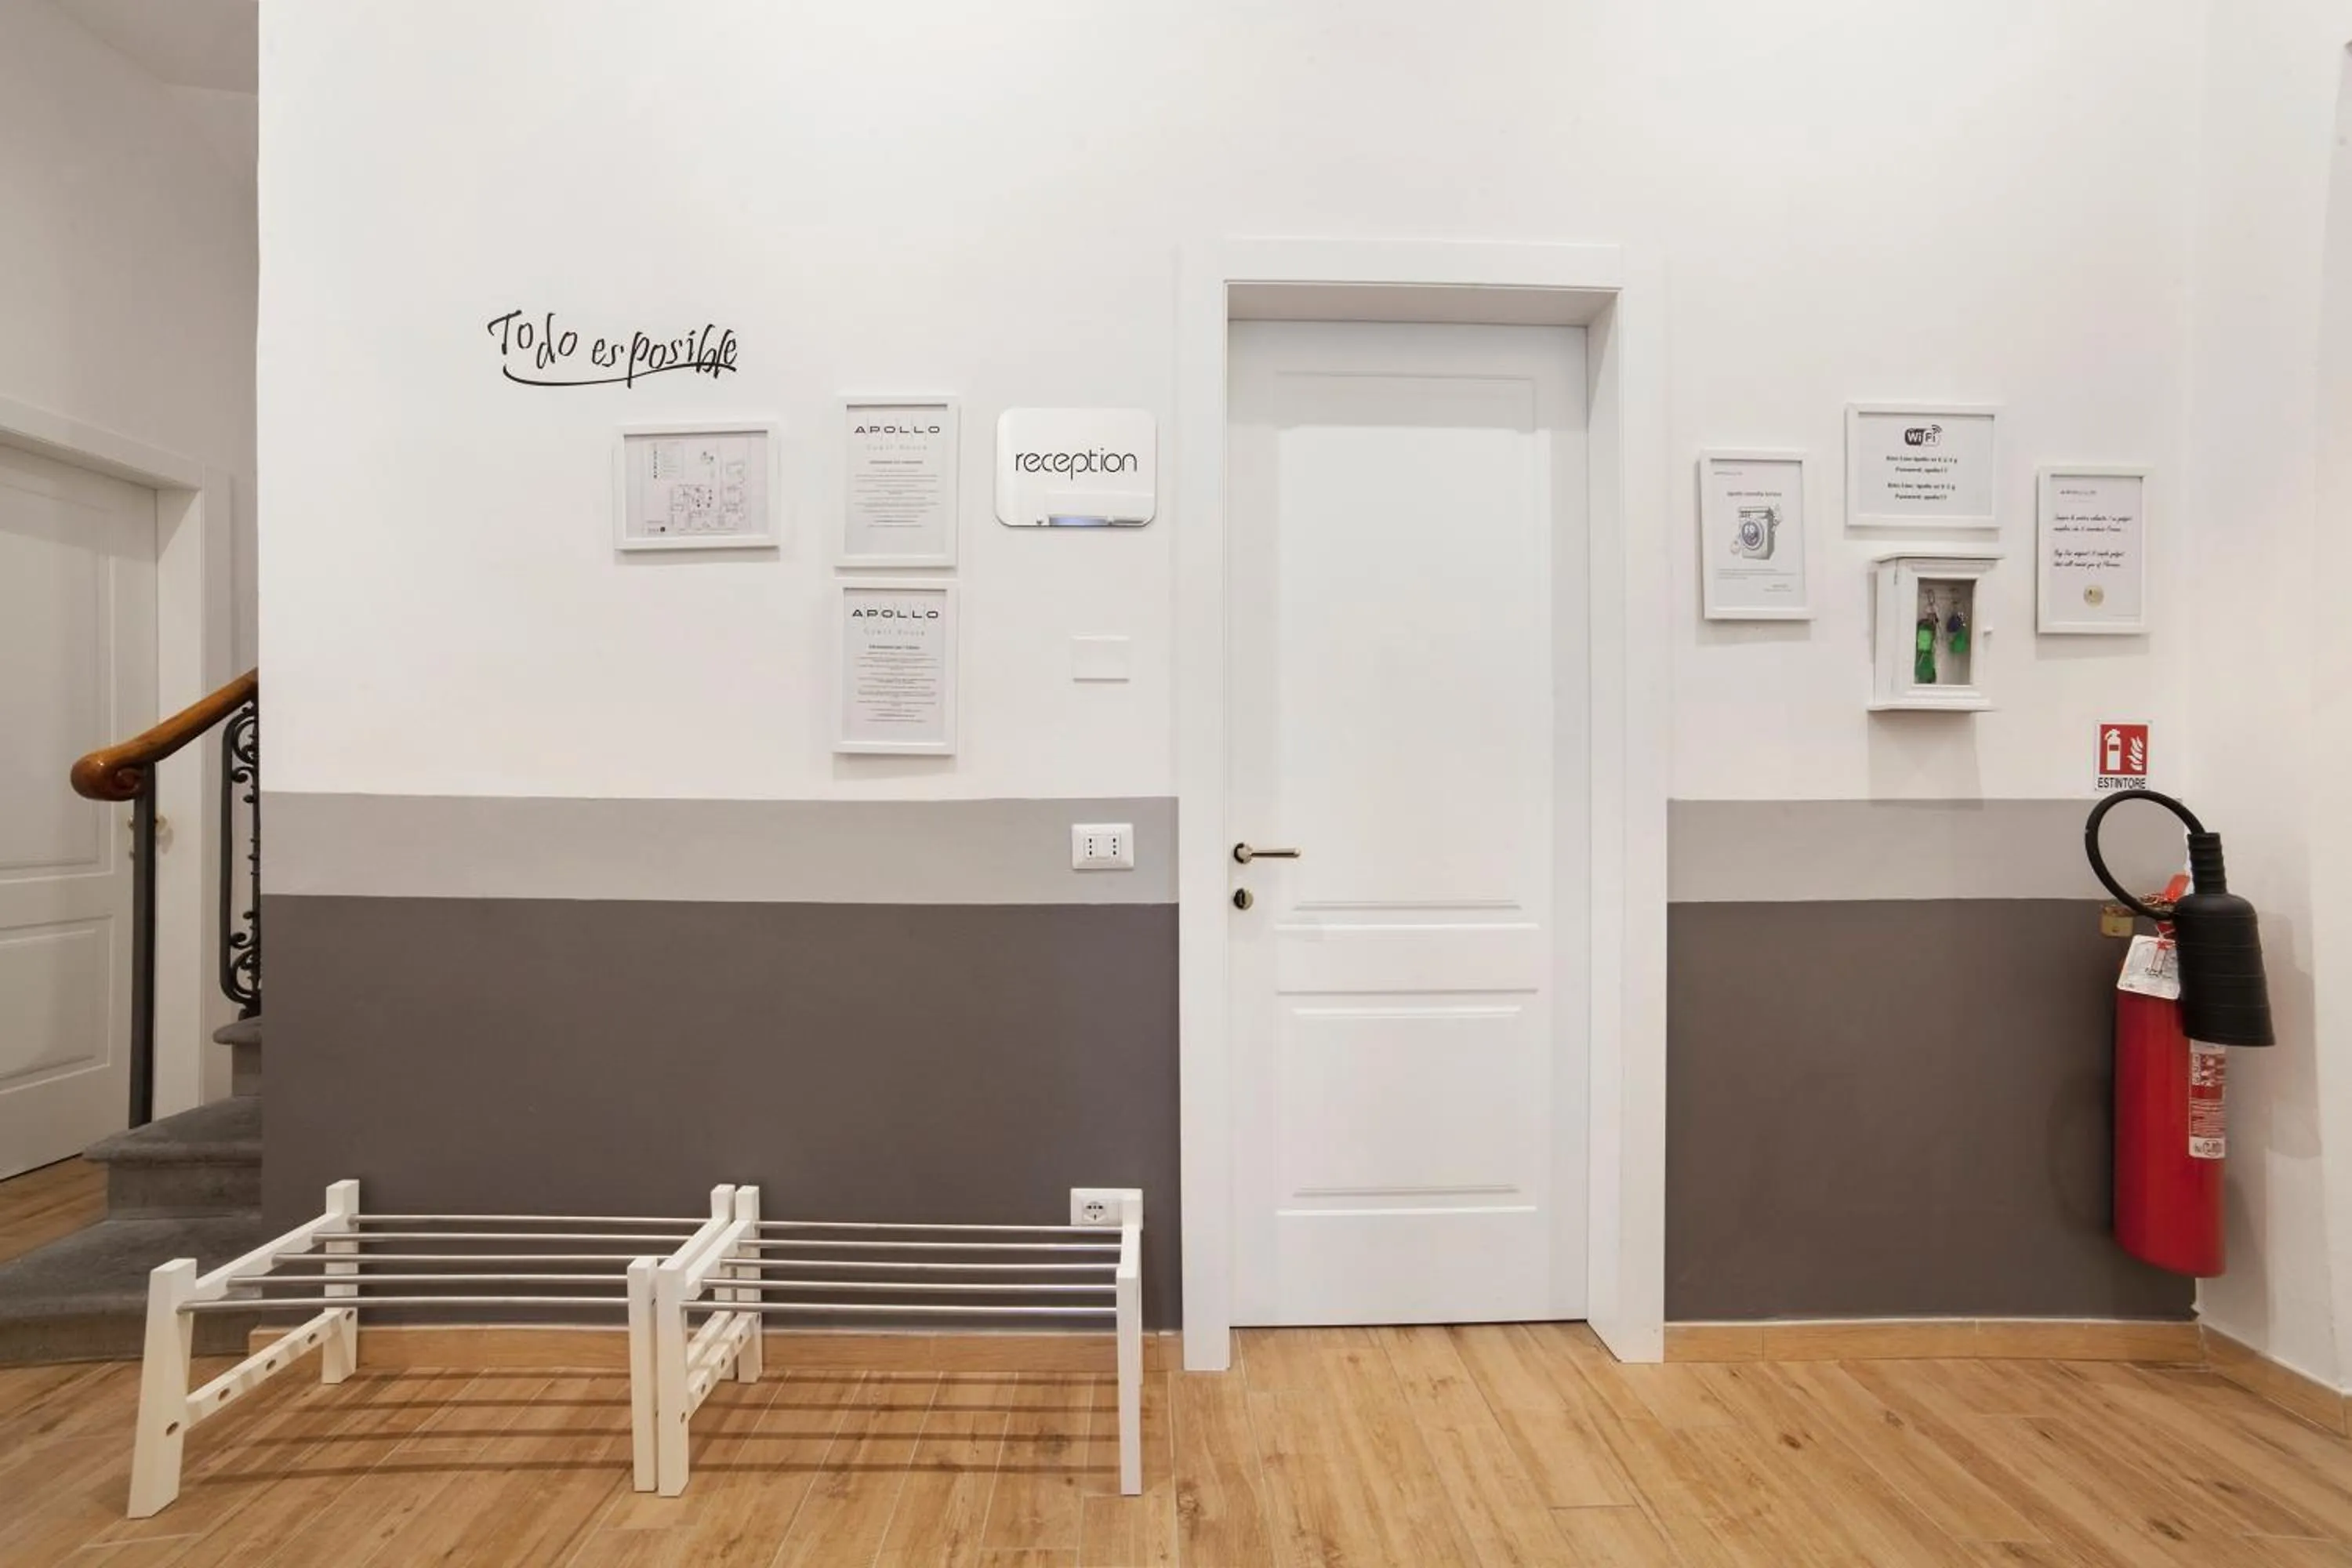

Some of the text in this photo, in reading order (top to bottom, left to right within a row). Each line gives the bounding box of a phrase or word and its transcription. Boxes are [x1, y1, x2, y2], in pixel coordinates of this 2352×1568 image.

[487, 310, 738, 390] Todo es posible
[854, 426, 941, 434] APOLLO
[1015, 447, 1138, 481] reception
[851, 608, 939, 619] APOLLO
[2097, 777, 2146, 789] ESTINTORE
